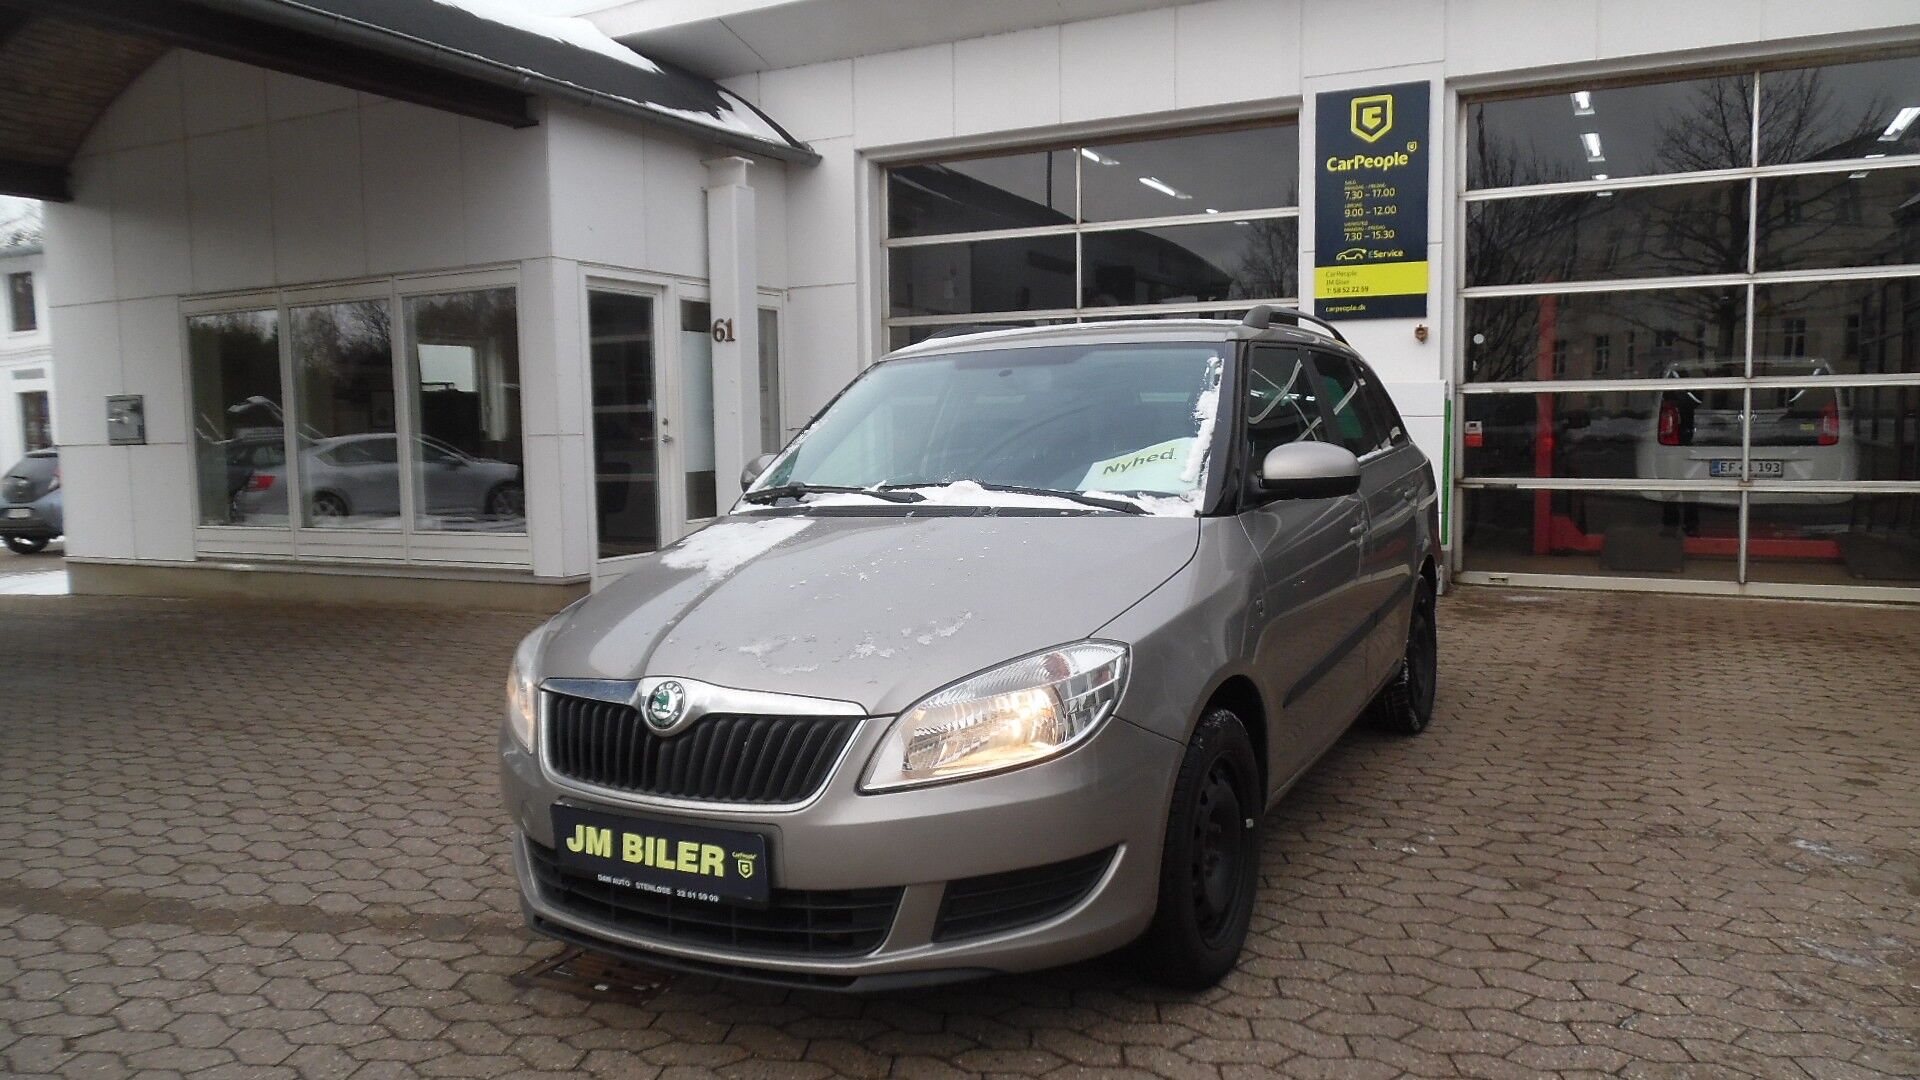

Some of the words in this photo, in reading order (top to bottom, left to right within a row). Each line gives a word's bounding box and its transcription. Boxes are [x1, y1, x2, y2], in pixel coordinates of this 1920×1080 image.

[1326, 151, 1409, 172] CarPeople
[1344, 190, 1363, 200] 7.30
[1372, 187, 1396, 198] 17.00
[1344, 207, 1364, 218] 9.00
[1373, 205, 1397, 216] 12.00
[1344, 232, 1362, 242] 7.30
[1372, 230, 1395, 240] 15.30
[712, 317, 736, 343] 61
[1720, 462, 1736, 473] EF
[1758, 462, 1780, 473] 193
[566, 824, 612, 859] JM
[621, 832, 726, 878] BILER
